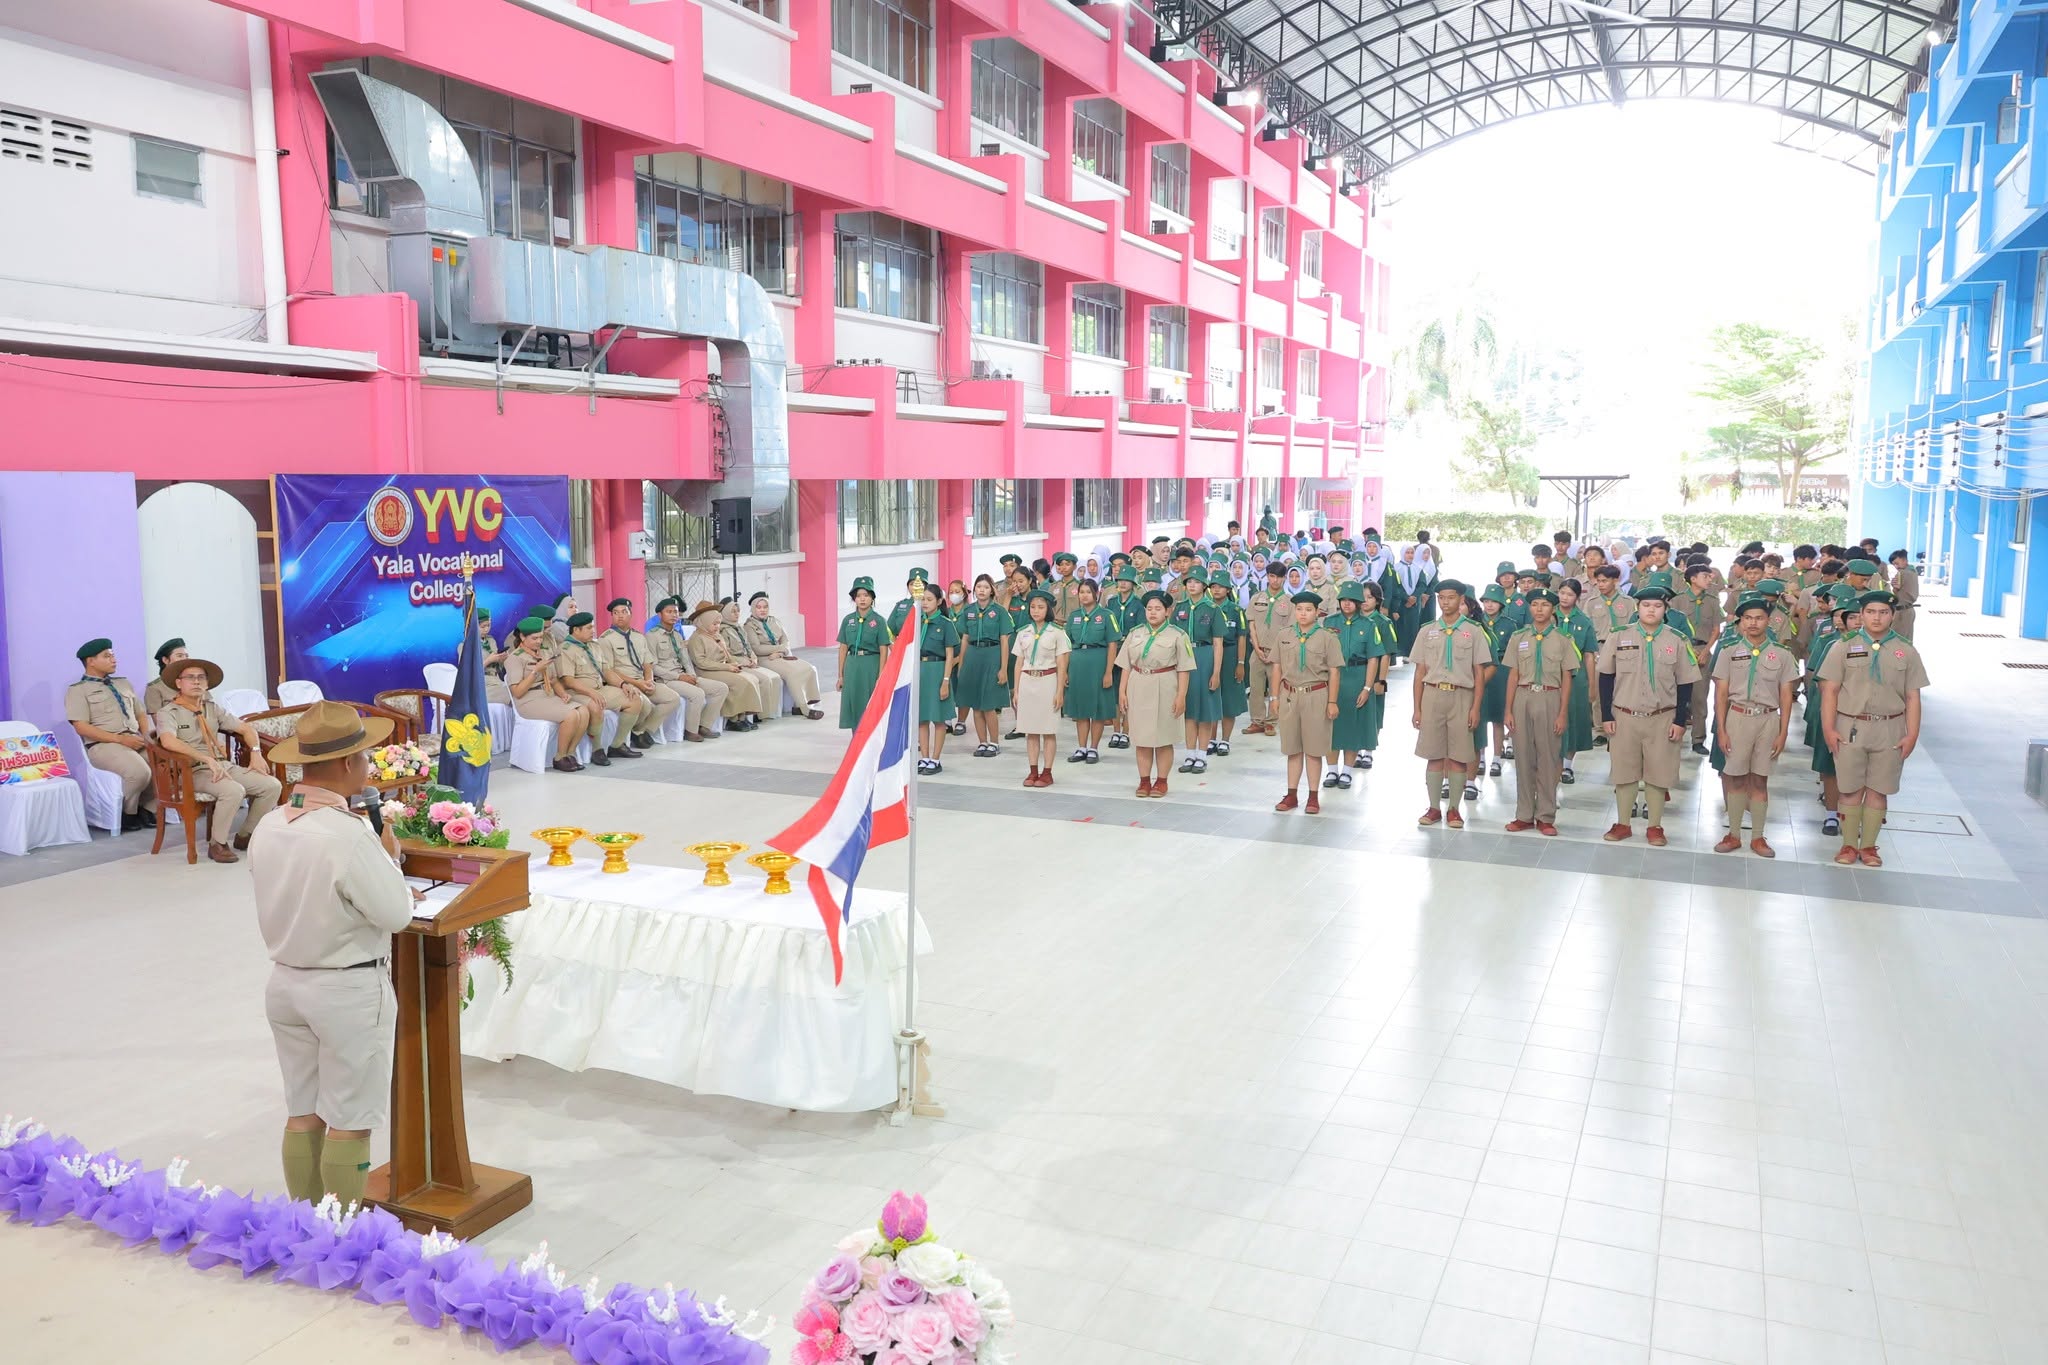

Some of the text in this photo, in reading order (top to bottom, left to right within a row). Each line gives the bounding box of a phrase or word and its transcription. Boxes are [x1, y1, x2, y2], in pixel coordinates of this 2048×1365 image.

[414, 487, 503, 542] YVC
[373, 549, 503, 577] Yala Vocatonal
[410, 580, 473, 603] Colleg
